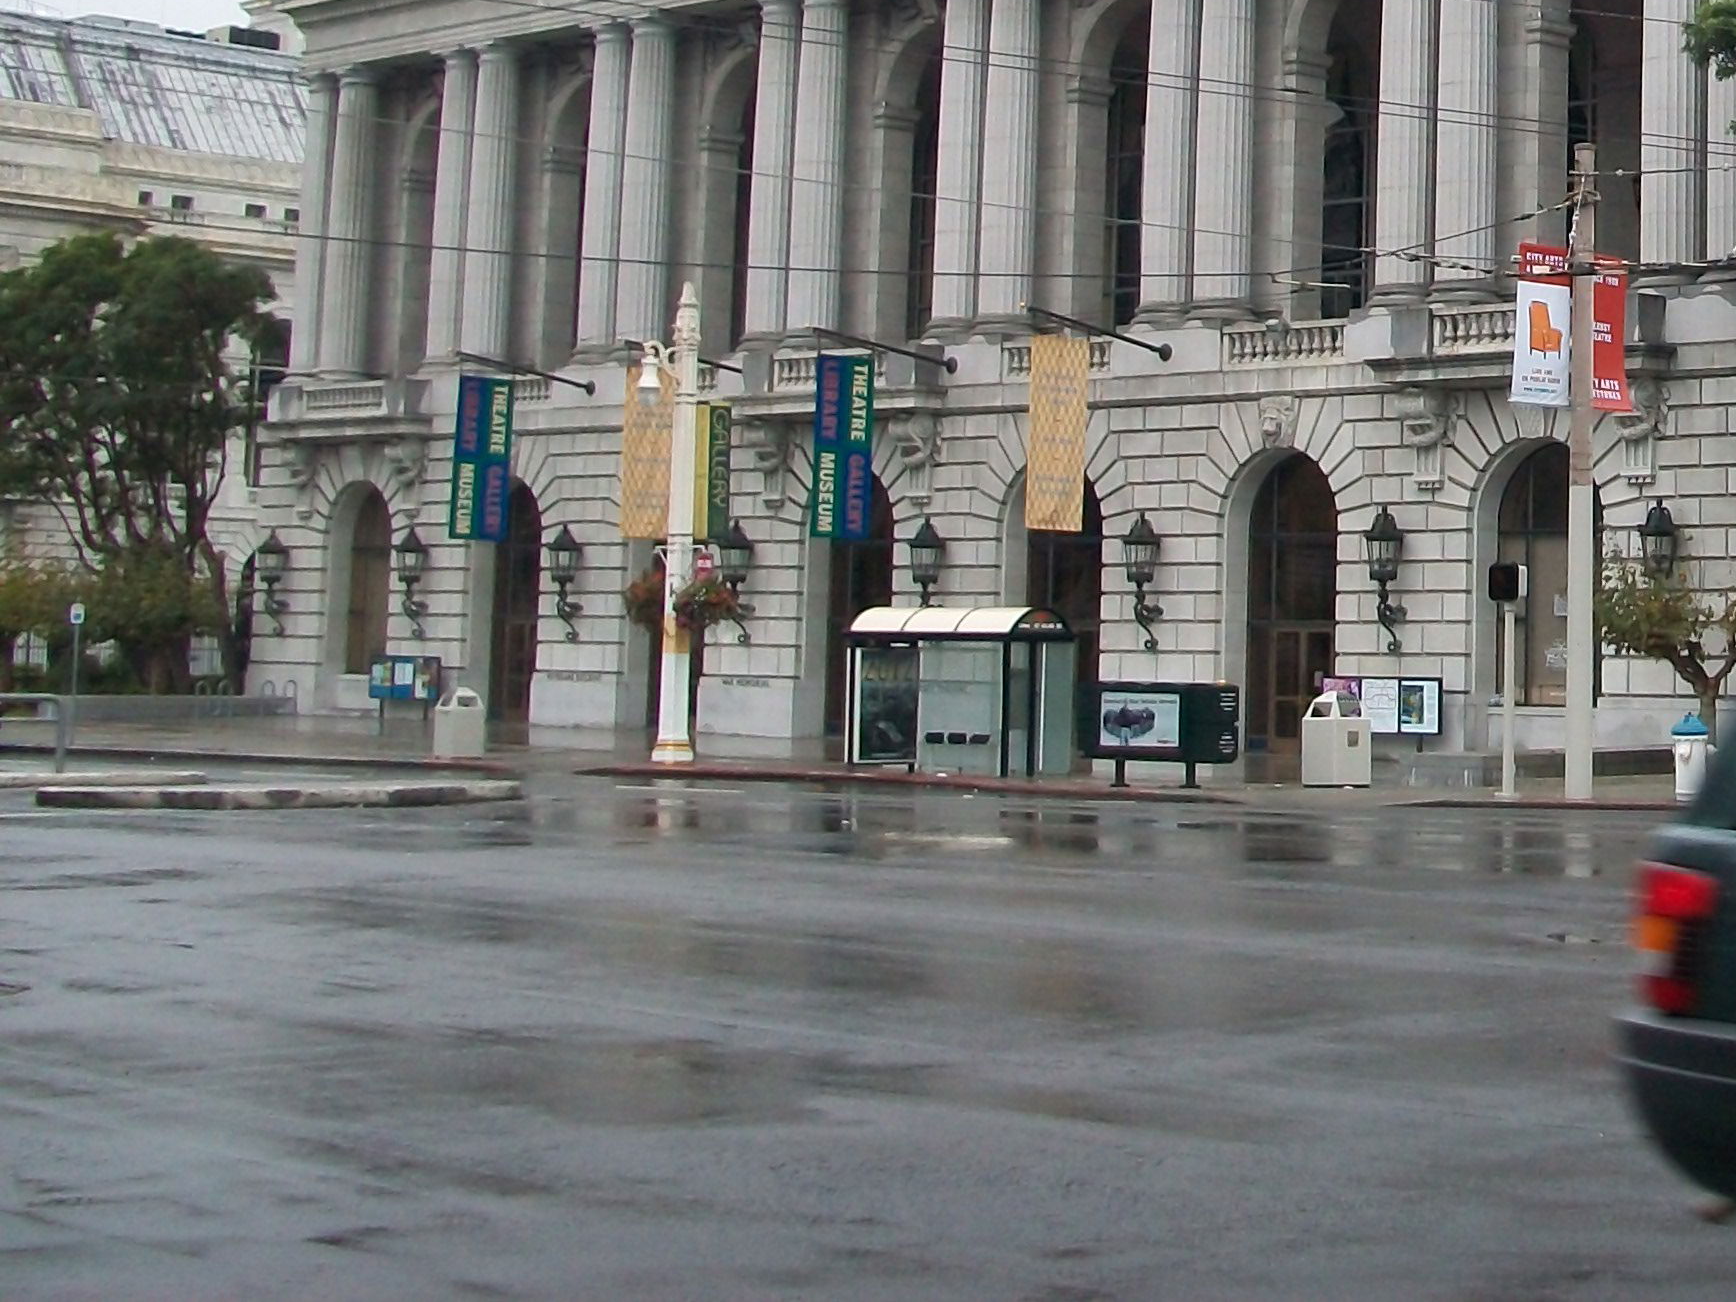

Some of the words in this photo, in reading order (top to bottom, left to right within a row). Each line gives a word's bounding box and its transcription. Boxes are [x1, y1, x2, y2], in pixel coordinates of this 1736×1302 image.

[489, 385, 509, 454] THEATRE
[821, 359, 840, 441] LIBRARY
[850, 364, 869, 442] THEATRE
[711, 409, 730, 507] GALLERY
[817, 452, 836, 532] MUSEUM
[846, 454, 866, 533] GALLERY
[455, 463, 475, 534] MUSEUM
[484, 465, 504, 534] GALLERY
